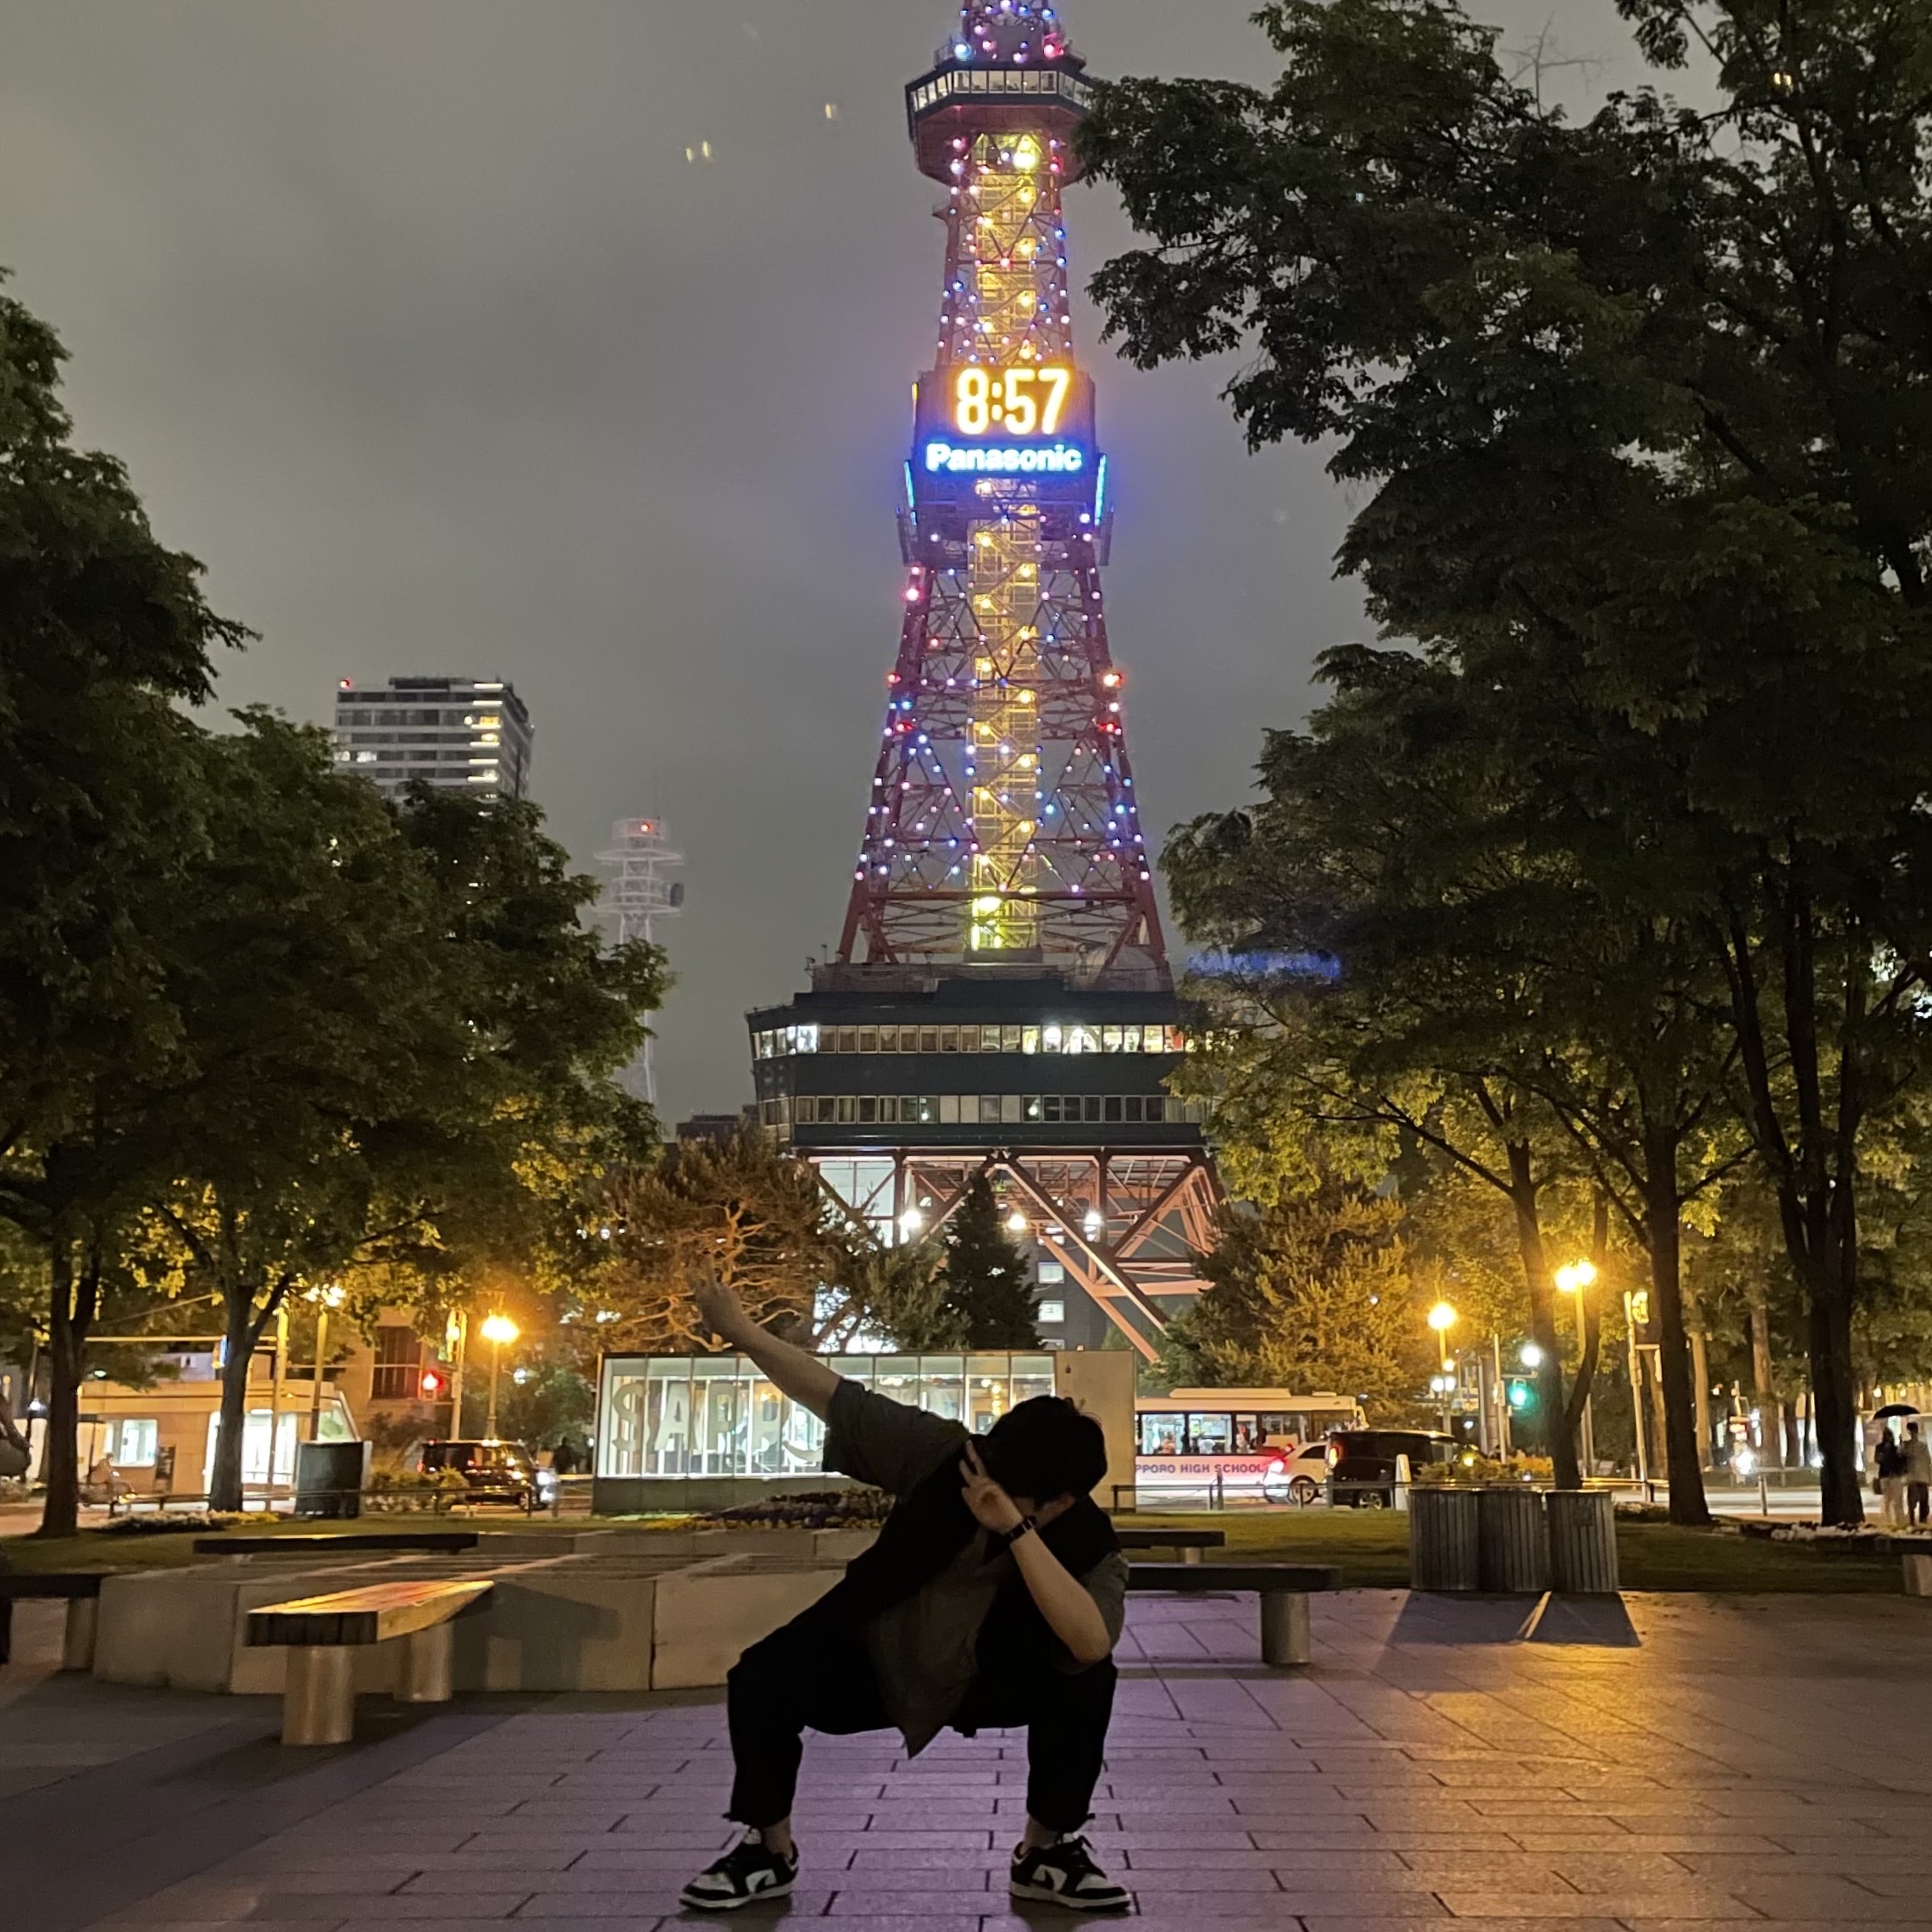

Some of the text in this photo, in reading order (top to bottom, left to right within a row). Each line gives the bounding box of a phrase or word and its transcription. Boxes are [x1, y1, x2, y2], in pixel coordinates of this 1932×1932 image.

[956, 367, 1069, 436] 8:57
[925, 442, 1082, 472] Panasonic
[1180, 1463, 1210, 1474] HIGH
[1214, 1463, 1264, 1474] SCHOOL
